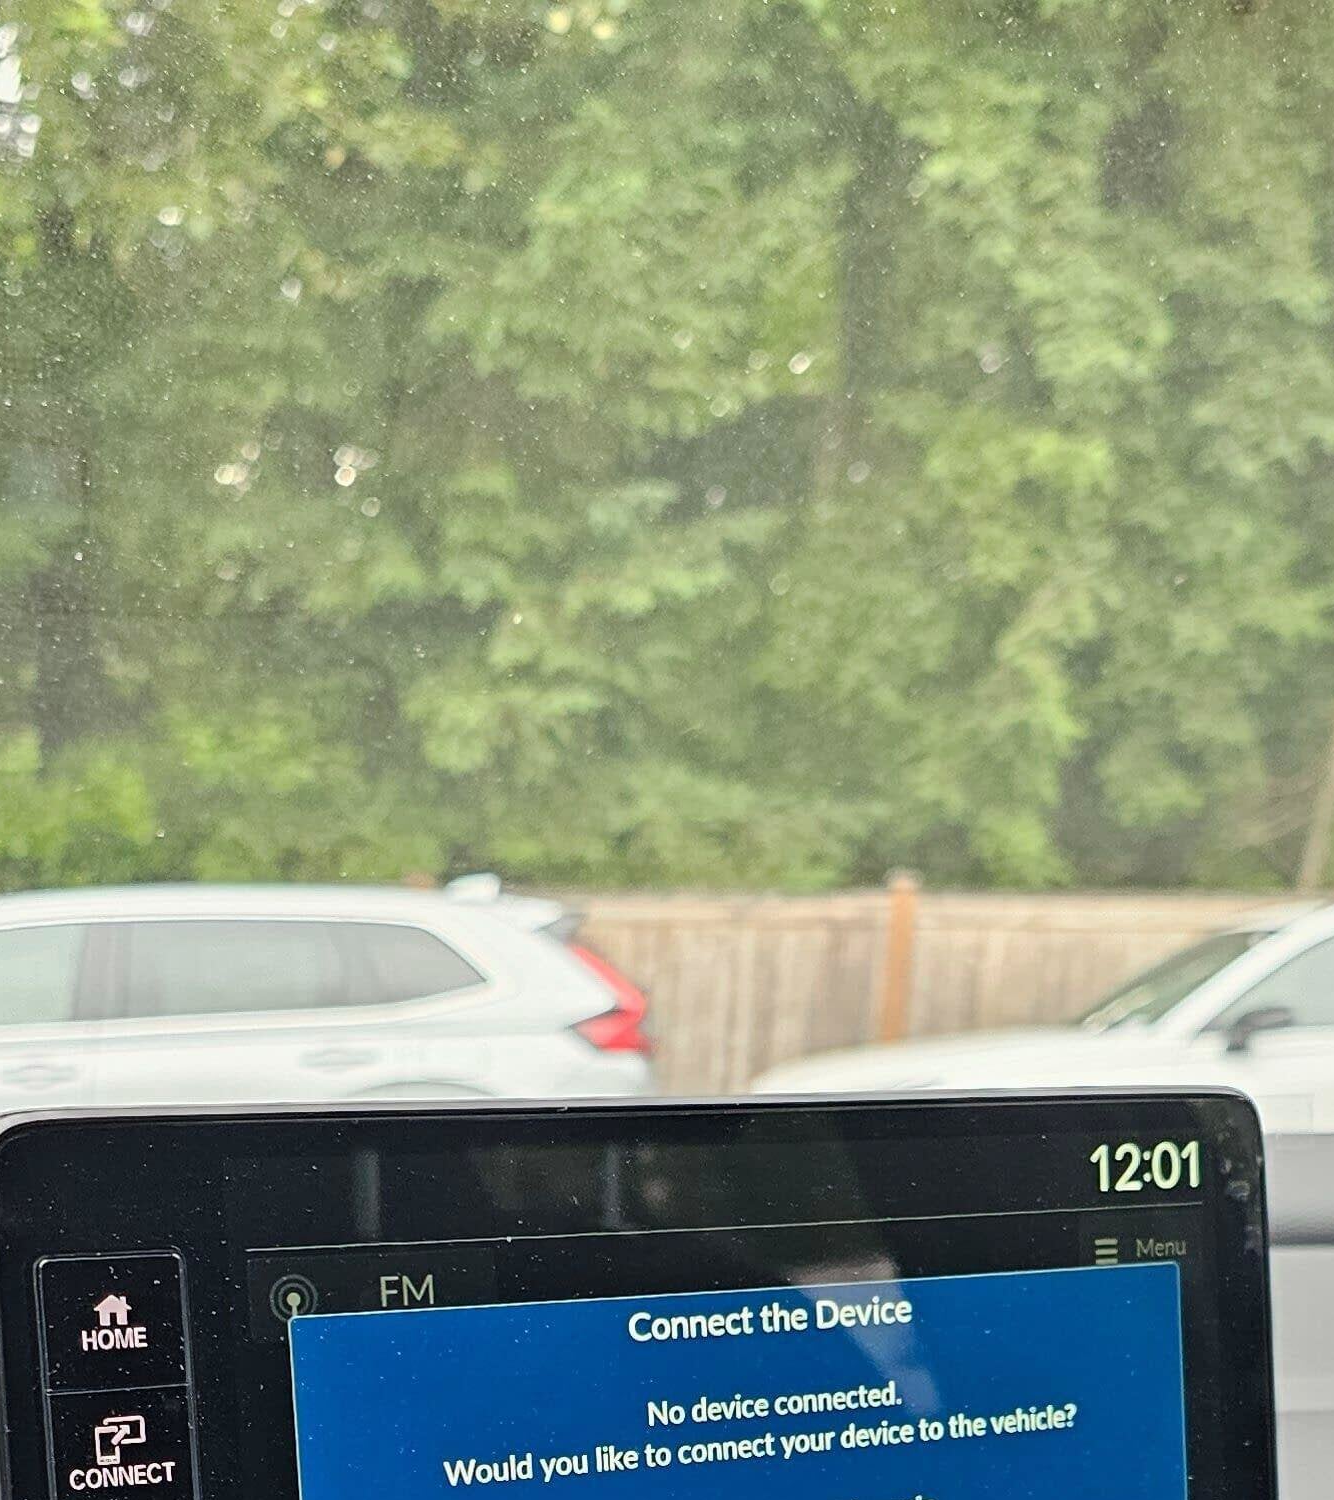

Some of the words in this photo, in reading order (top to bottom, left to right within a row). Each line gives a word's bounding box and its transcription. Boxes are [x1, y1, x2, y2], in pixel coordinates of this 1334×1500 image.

[1090, 1141, 1201, 1193] 12:01
[1136, 1237, 1186, 1257] Menu
[380, 1275, 434, 1307] FM
[81, 1327, 147, 1351] HOME
[628, 1304, 753, 1343] Connect
[760, 1300, 807, 1333] the
[816, 1297, 912, 1330] Device
[647, 1401, 685, 1427] No
[691, 1393, 768, 1422] device
[775, 1382, 902, 1415] connected.
[444, 1452, 532, 1486] Would
[540, 1454, 588, 1482] you
[595, 1446, 639, 1473] like
[645, 1444, 672, 1468] to
[677, 1433, 775, 1464] connect
[780, 1431, 833, 1460] your
[840, 1420, 914, 1450] device
[919, 1419, 944, 1442] to
[949, 1412, 985, 1438] the
[991, 1404, 1077, 1434] vehicle?
[70, 1462, 175, 1490] CONNECT
